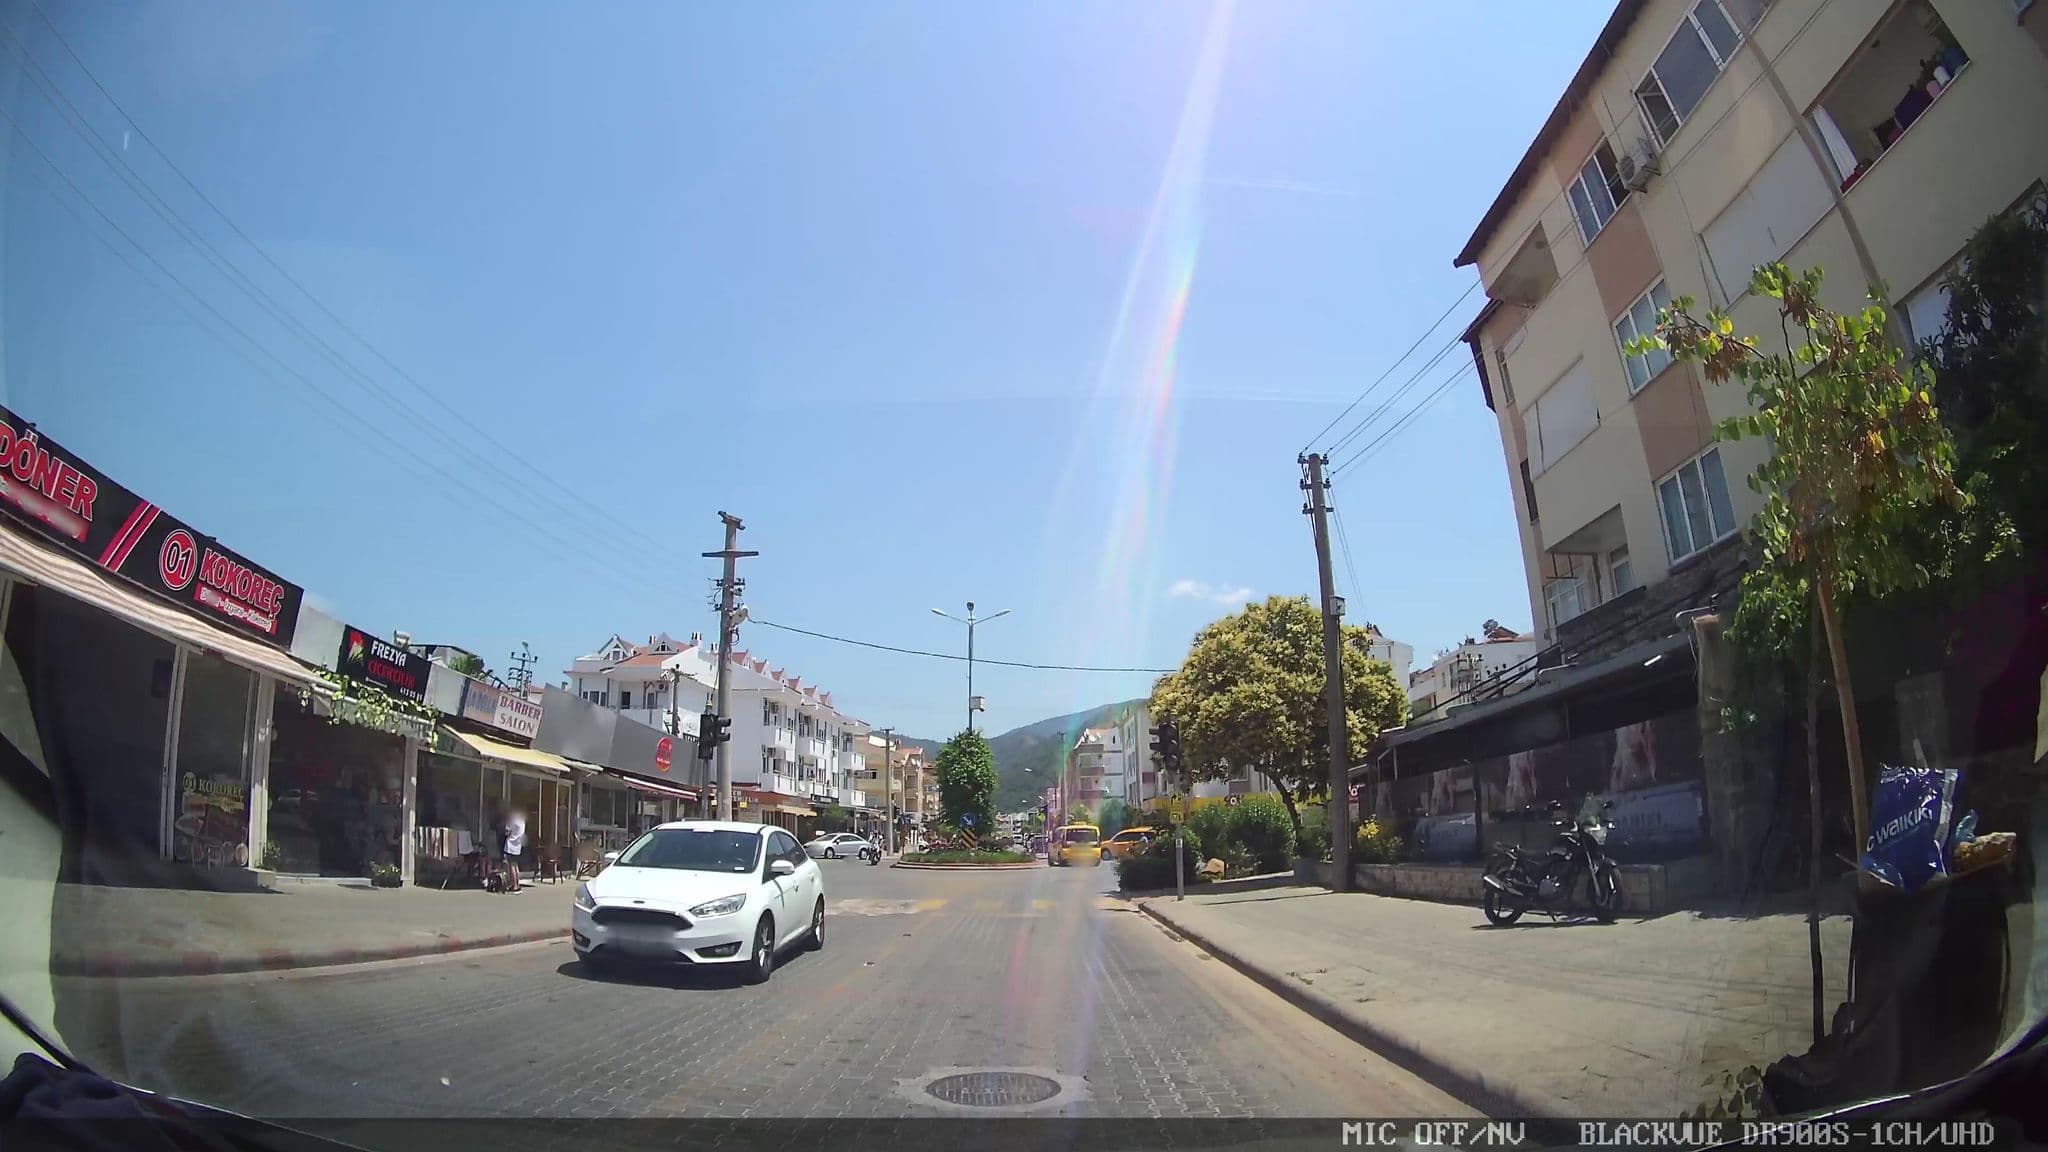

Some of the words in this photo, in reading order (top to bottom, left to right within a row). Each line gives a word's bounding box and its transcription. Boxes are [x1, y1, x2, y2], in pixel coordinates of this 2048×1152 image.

[0, 419, 98, 521] DÖNER
[166, 540, 193, 579] 01
[199, 548, 284, 620] KOKOREÇ
[371, 640, 407, 666] FREZYA
[499, 695, 541, 721] BARBER
[500, 713, 535, 735] SALON
